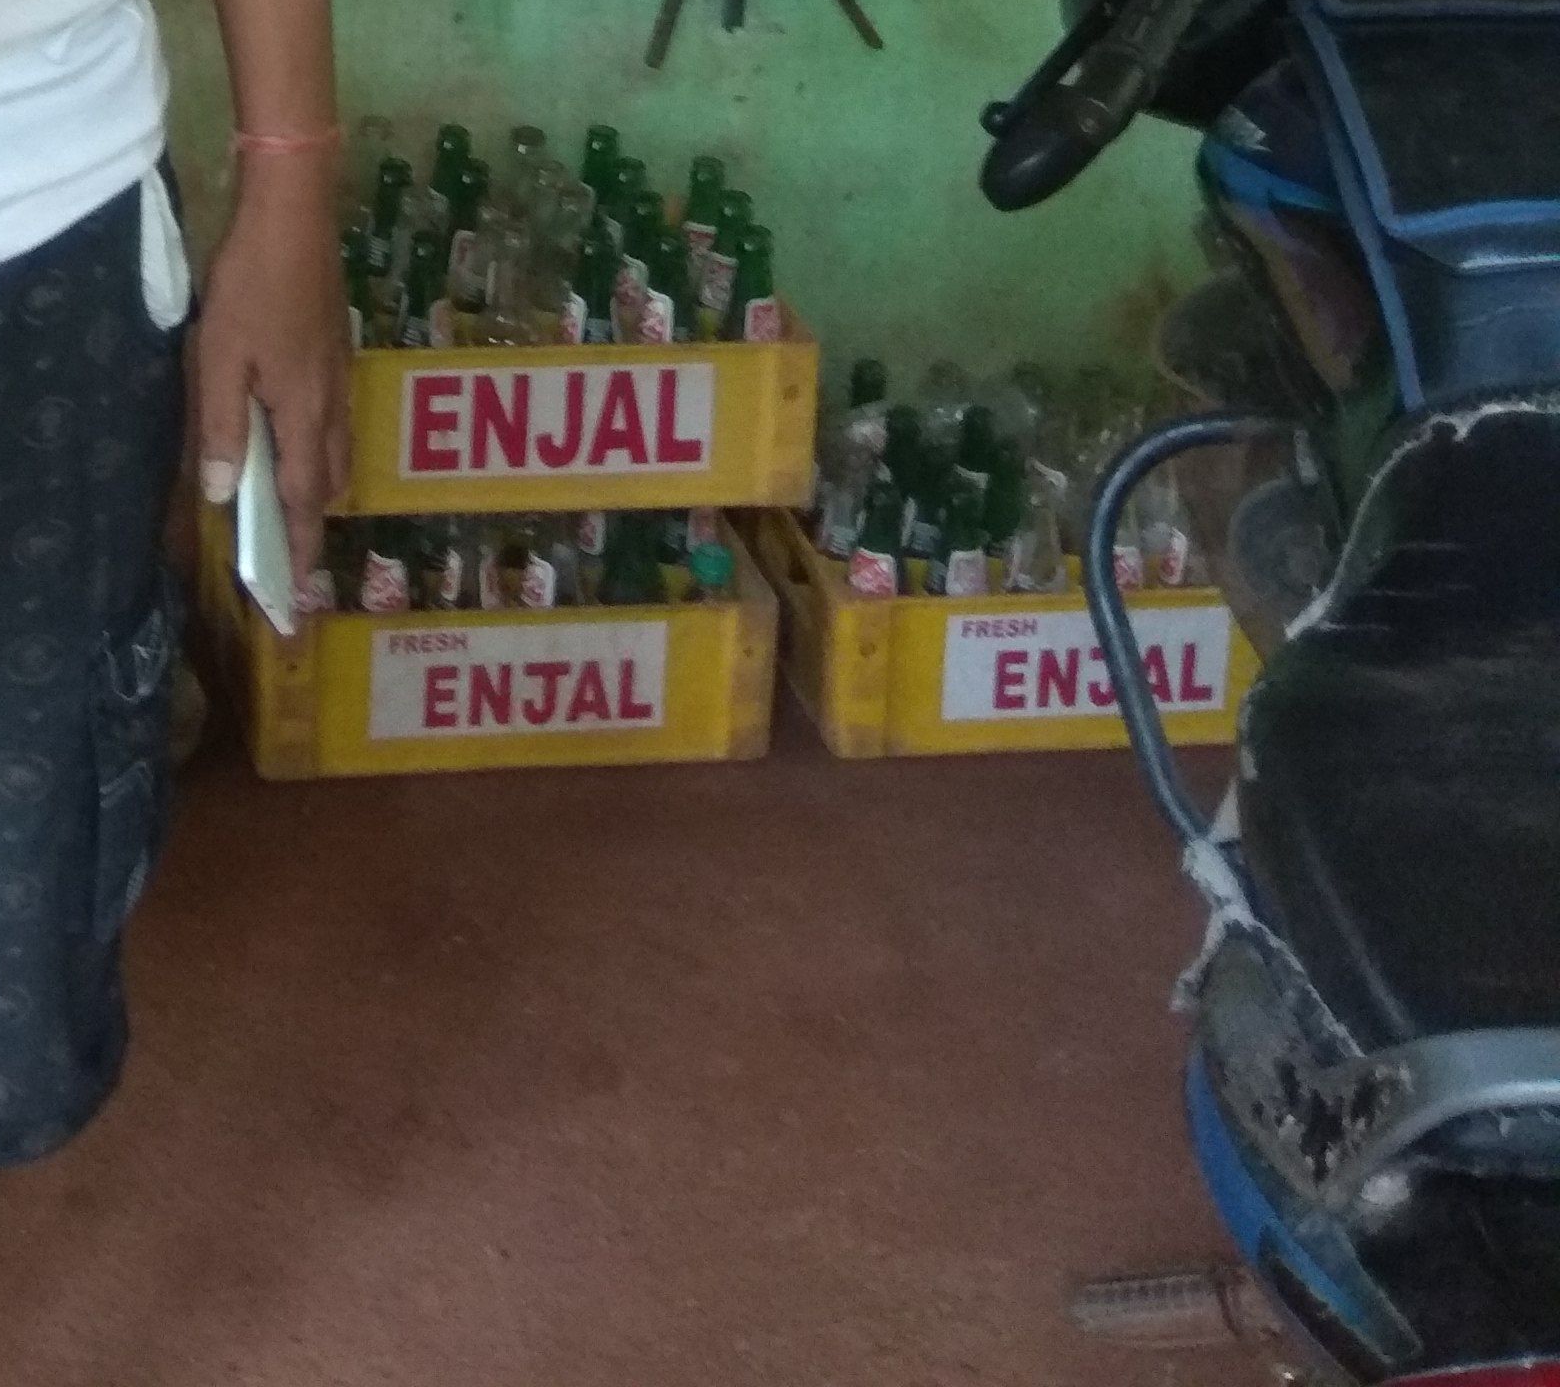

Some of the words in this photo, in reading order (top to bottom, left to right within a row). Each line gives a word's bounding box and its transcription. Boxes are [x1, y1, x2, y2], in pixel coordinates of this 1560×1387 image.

[409, 369, 703, 473] ENJAL
[388, 631, 469, 655] FRESH
[960, 618, 1038, 639] FRESH
[421, 658, 654, 728] ENJAL
